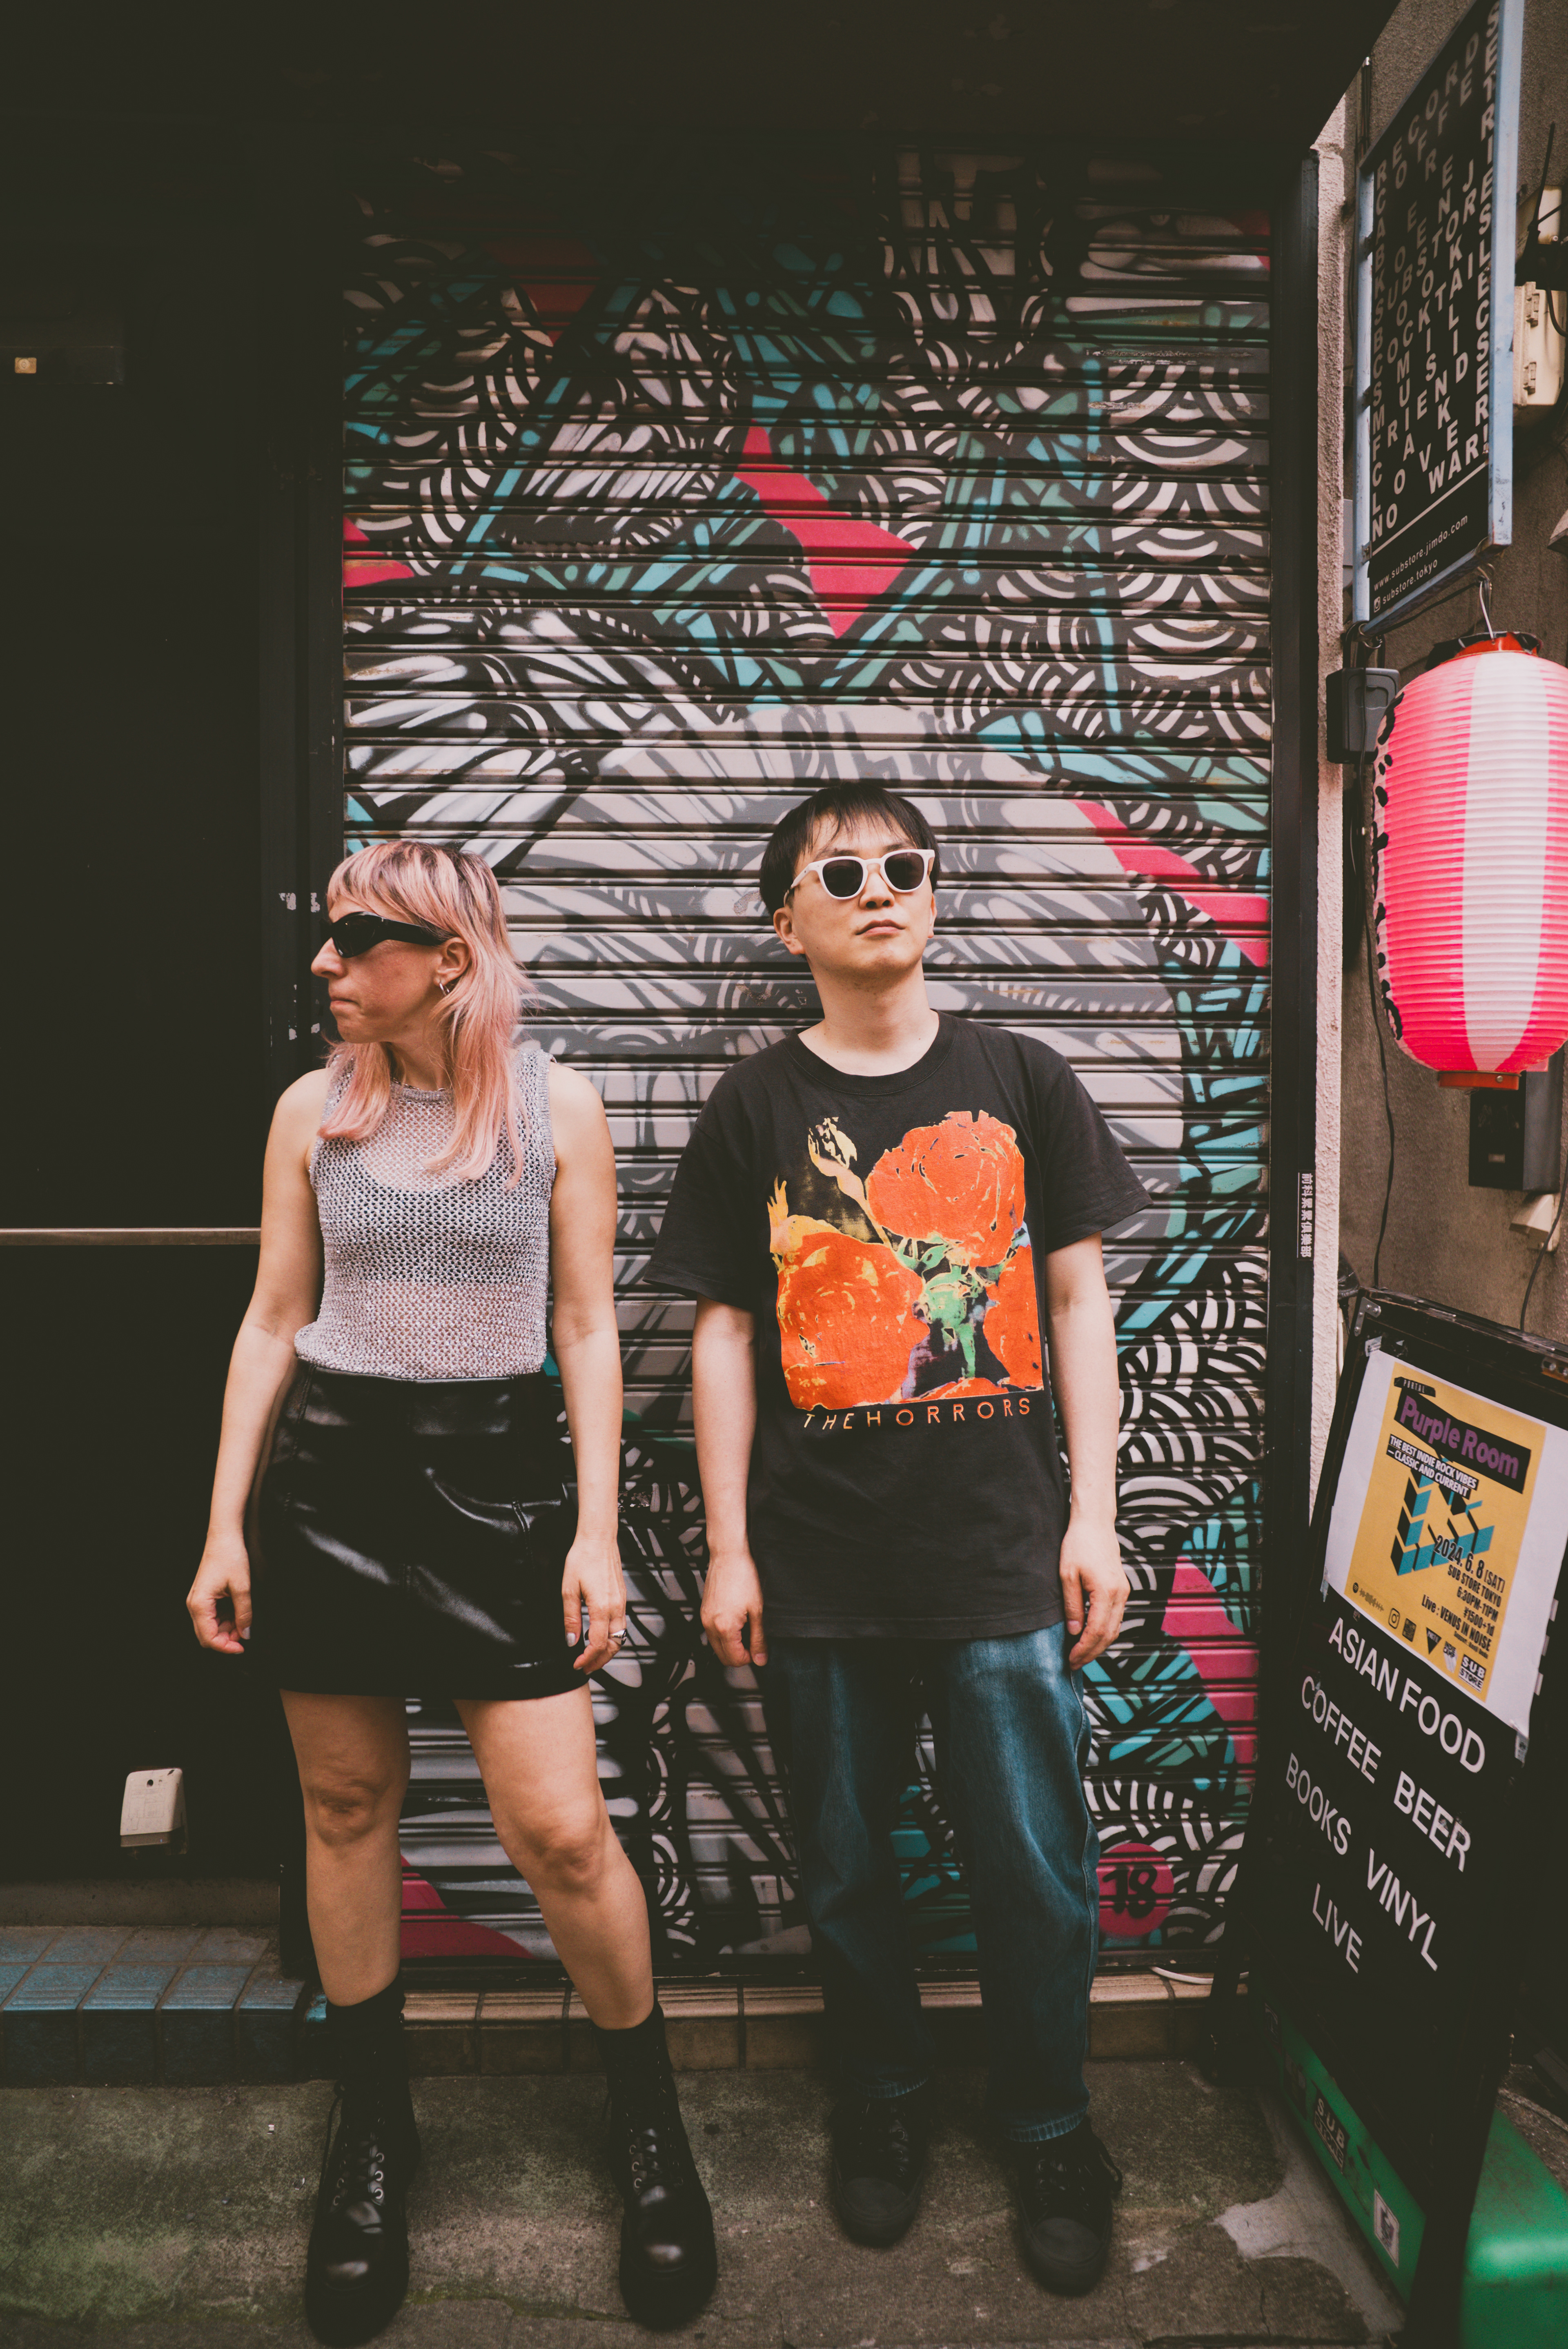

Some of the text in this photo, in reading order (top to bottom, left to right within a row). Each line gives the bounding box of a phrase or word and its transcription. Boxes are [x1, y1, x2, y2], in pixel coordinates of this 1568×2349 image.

[1376, 1, 1499, 185] RECORDS
[1376, 40, 1498, 216] COFFEE
[1374, 203, 1492, 354] BOOKS
[1372, 503, 1398, 543] NO
[1374, 515, 1468, 591] www.substore.jimdo.com
[1383, 559, 1437, 604] substore.tokyo
[804, 1398, 1030, 1430] THE HORRORS
[1400, 1395, 1519, 1479] Purple Room
[1390, 1435, 1477, 1489] THE BEST INDIE ROCK VIBES
[1394, 1450, 1419, 1470] CLASSIC
[1418, 1465, 1435, 1478] AND
[1435, 1472, 1469, 1496] CURRENT
[1421, 1594, 1437, 1613] Live
[1440, 1605, 1462, 1630] VENUS
[1461, 1621, 1470, 1637] IN
[1469, 1626, 1492, 1652] NOISE
[1448, 1564, 1502, 1608] SUB STORE TOKYO
[1328, 1617, 1485, 1773] ASIAN FOOD
[1302, 1676, 1471, 1872] COFFEE BEER
[1286, 1752, 1438, 1971] BOOKS VINYL
[1312, 1883, 1362, 1973] LIVE
